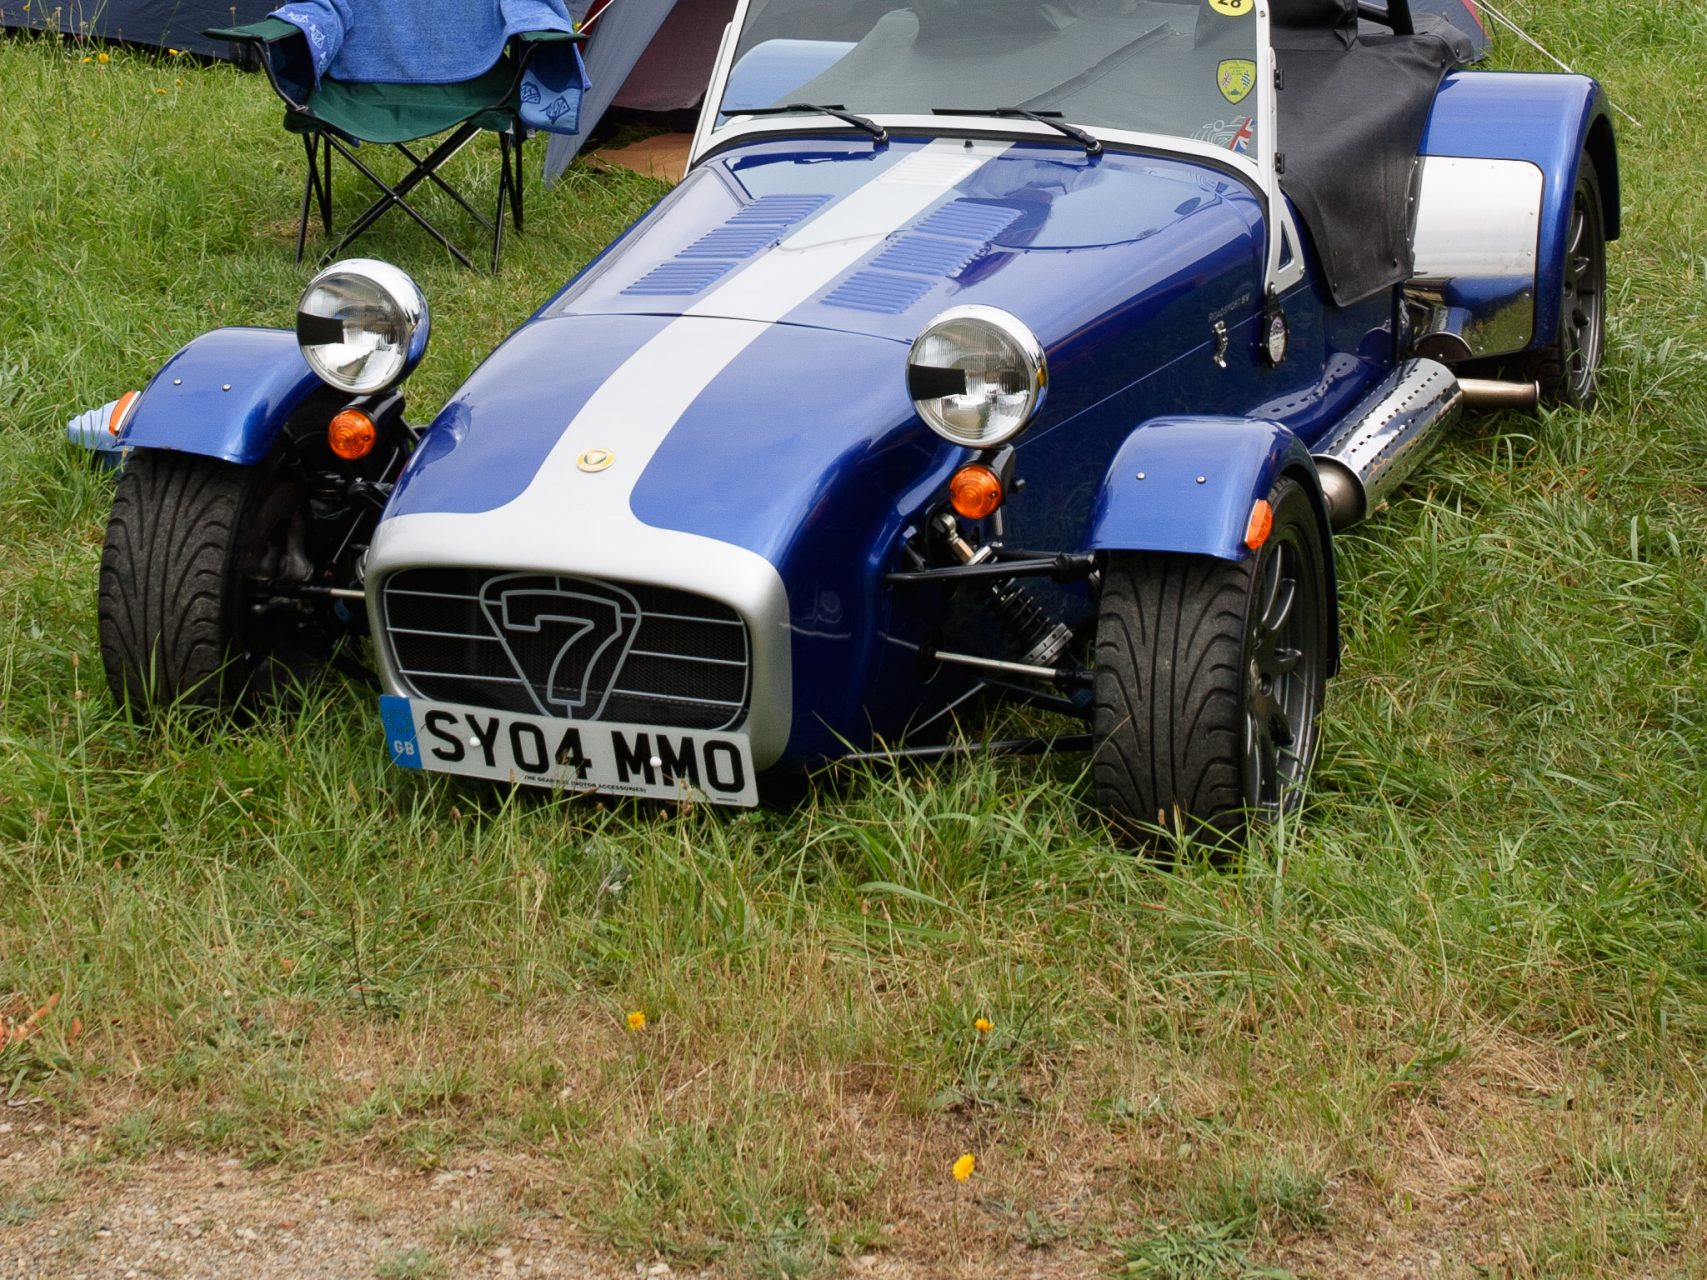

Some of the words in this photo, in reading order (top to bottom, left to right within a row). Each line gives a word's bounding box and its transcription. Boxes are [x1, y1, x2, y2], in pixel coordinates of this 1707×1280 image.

[501, 589, 623, 707] 7
[394, 739, 415, 756] GB
[425, 709, 592, 780] SY04
[611, 730, 746, 793] MMO
